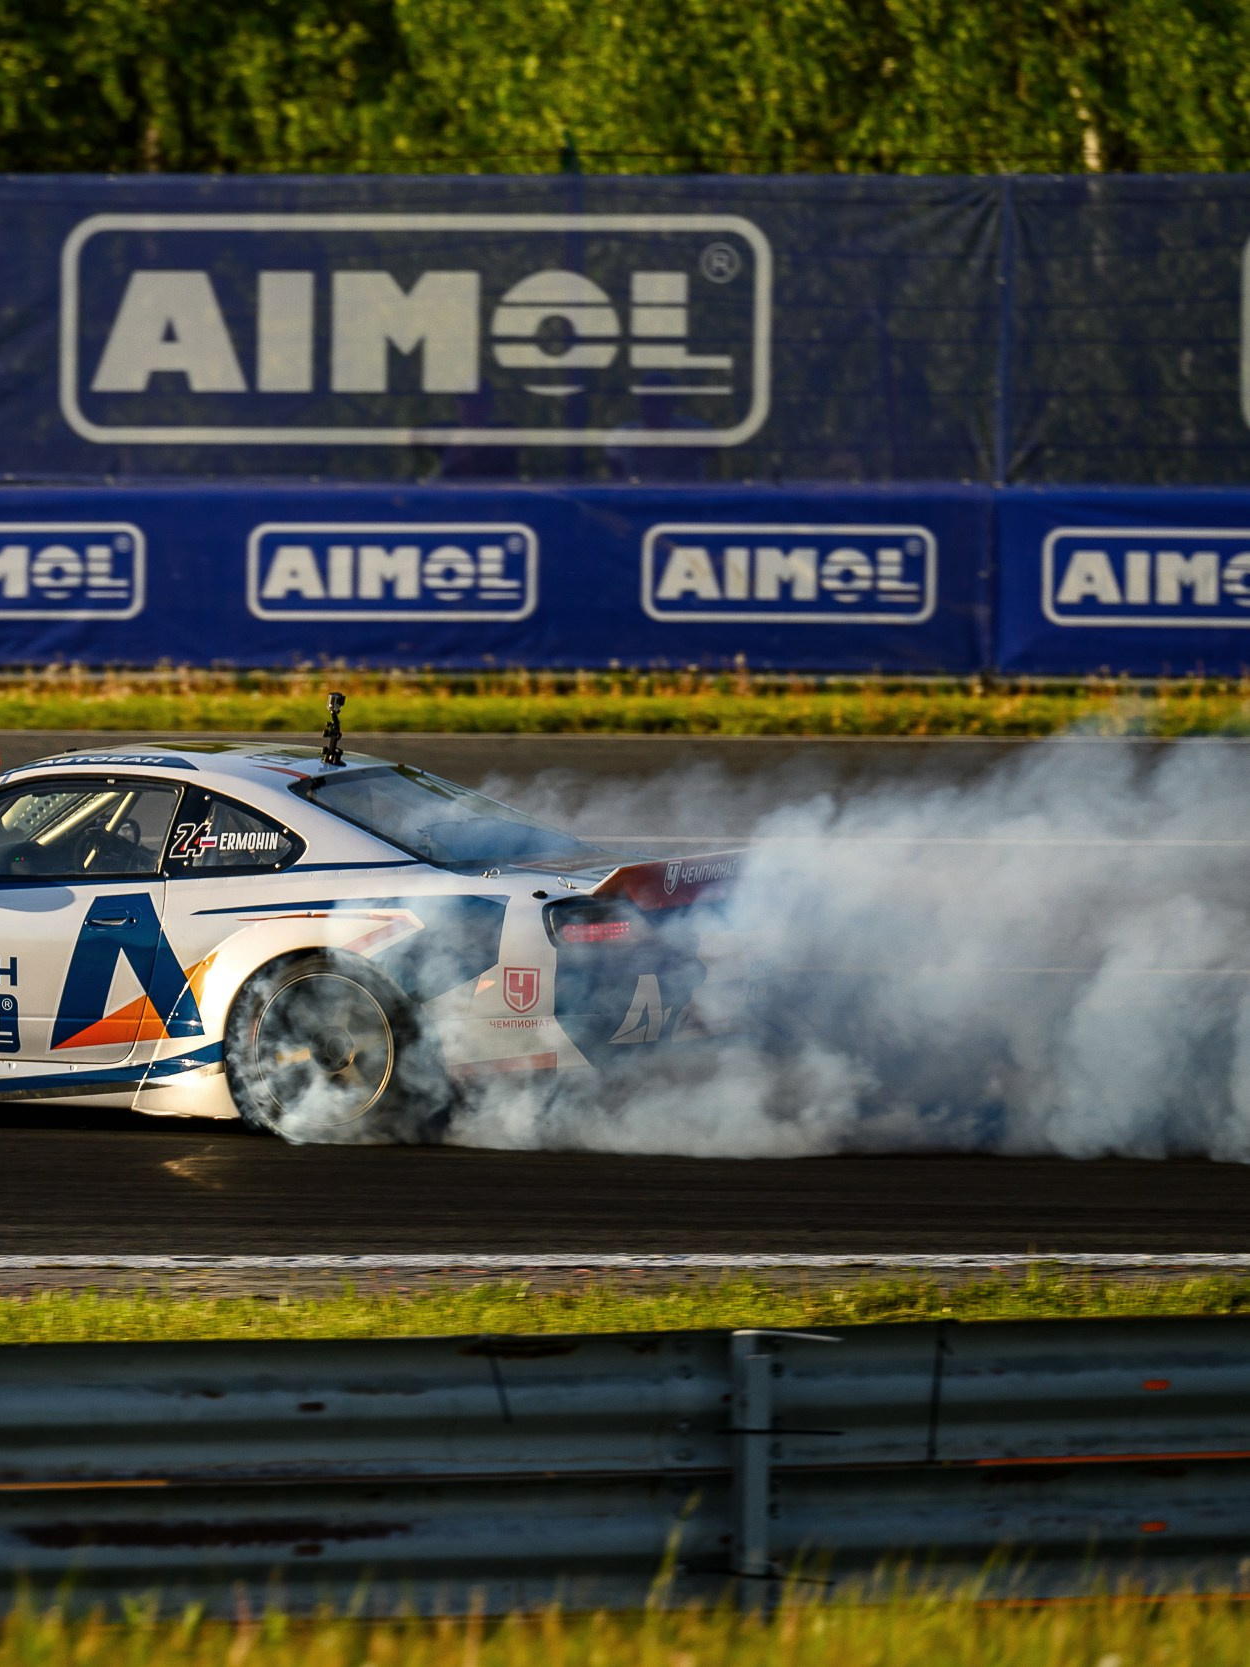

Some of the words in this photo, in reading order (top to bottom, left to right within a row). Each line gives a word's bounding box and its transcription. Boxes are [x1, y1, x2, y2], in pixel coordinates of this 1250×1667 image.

[168, 822, 212, 858] 24
[219, 832, 279, 851] ERMOHIN
[681, 860, 738, 884] ЧЕМПИОНАТ
[490, 1019, 551, 1029] ЧЕМПИОНАТ
